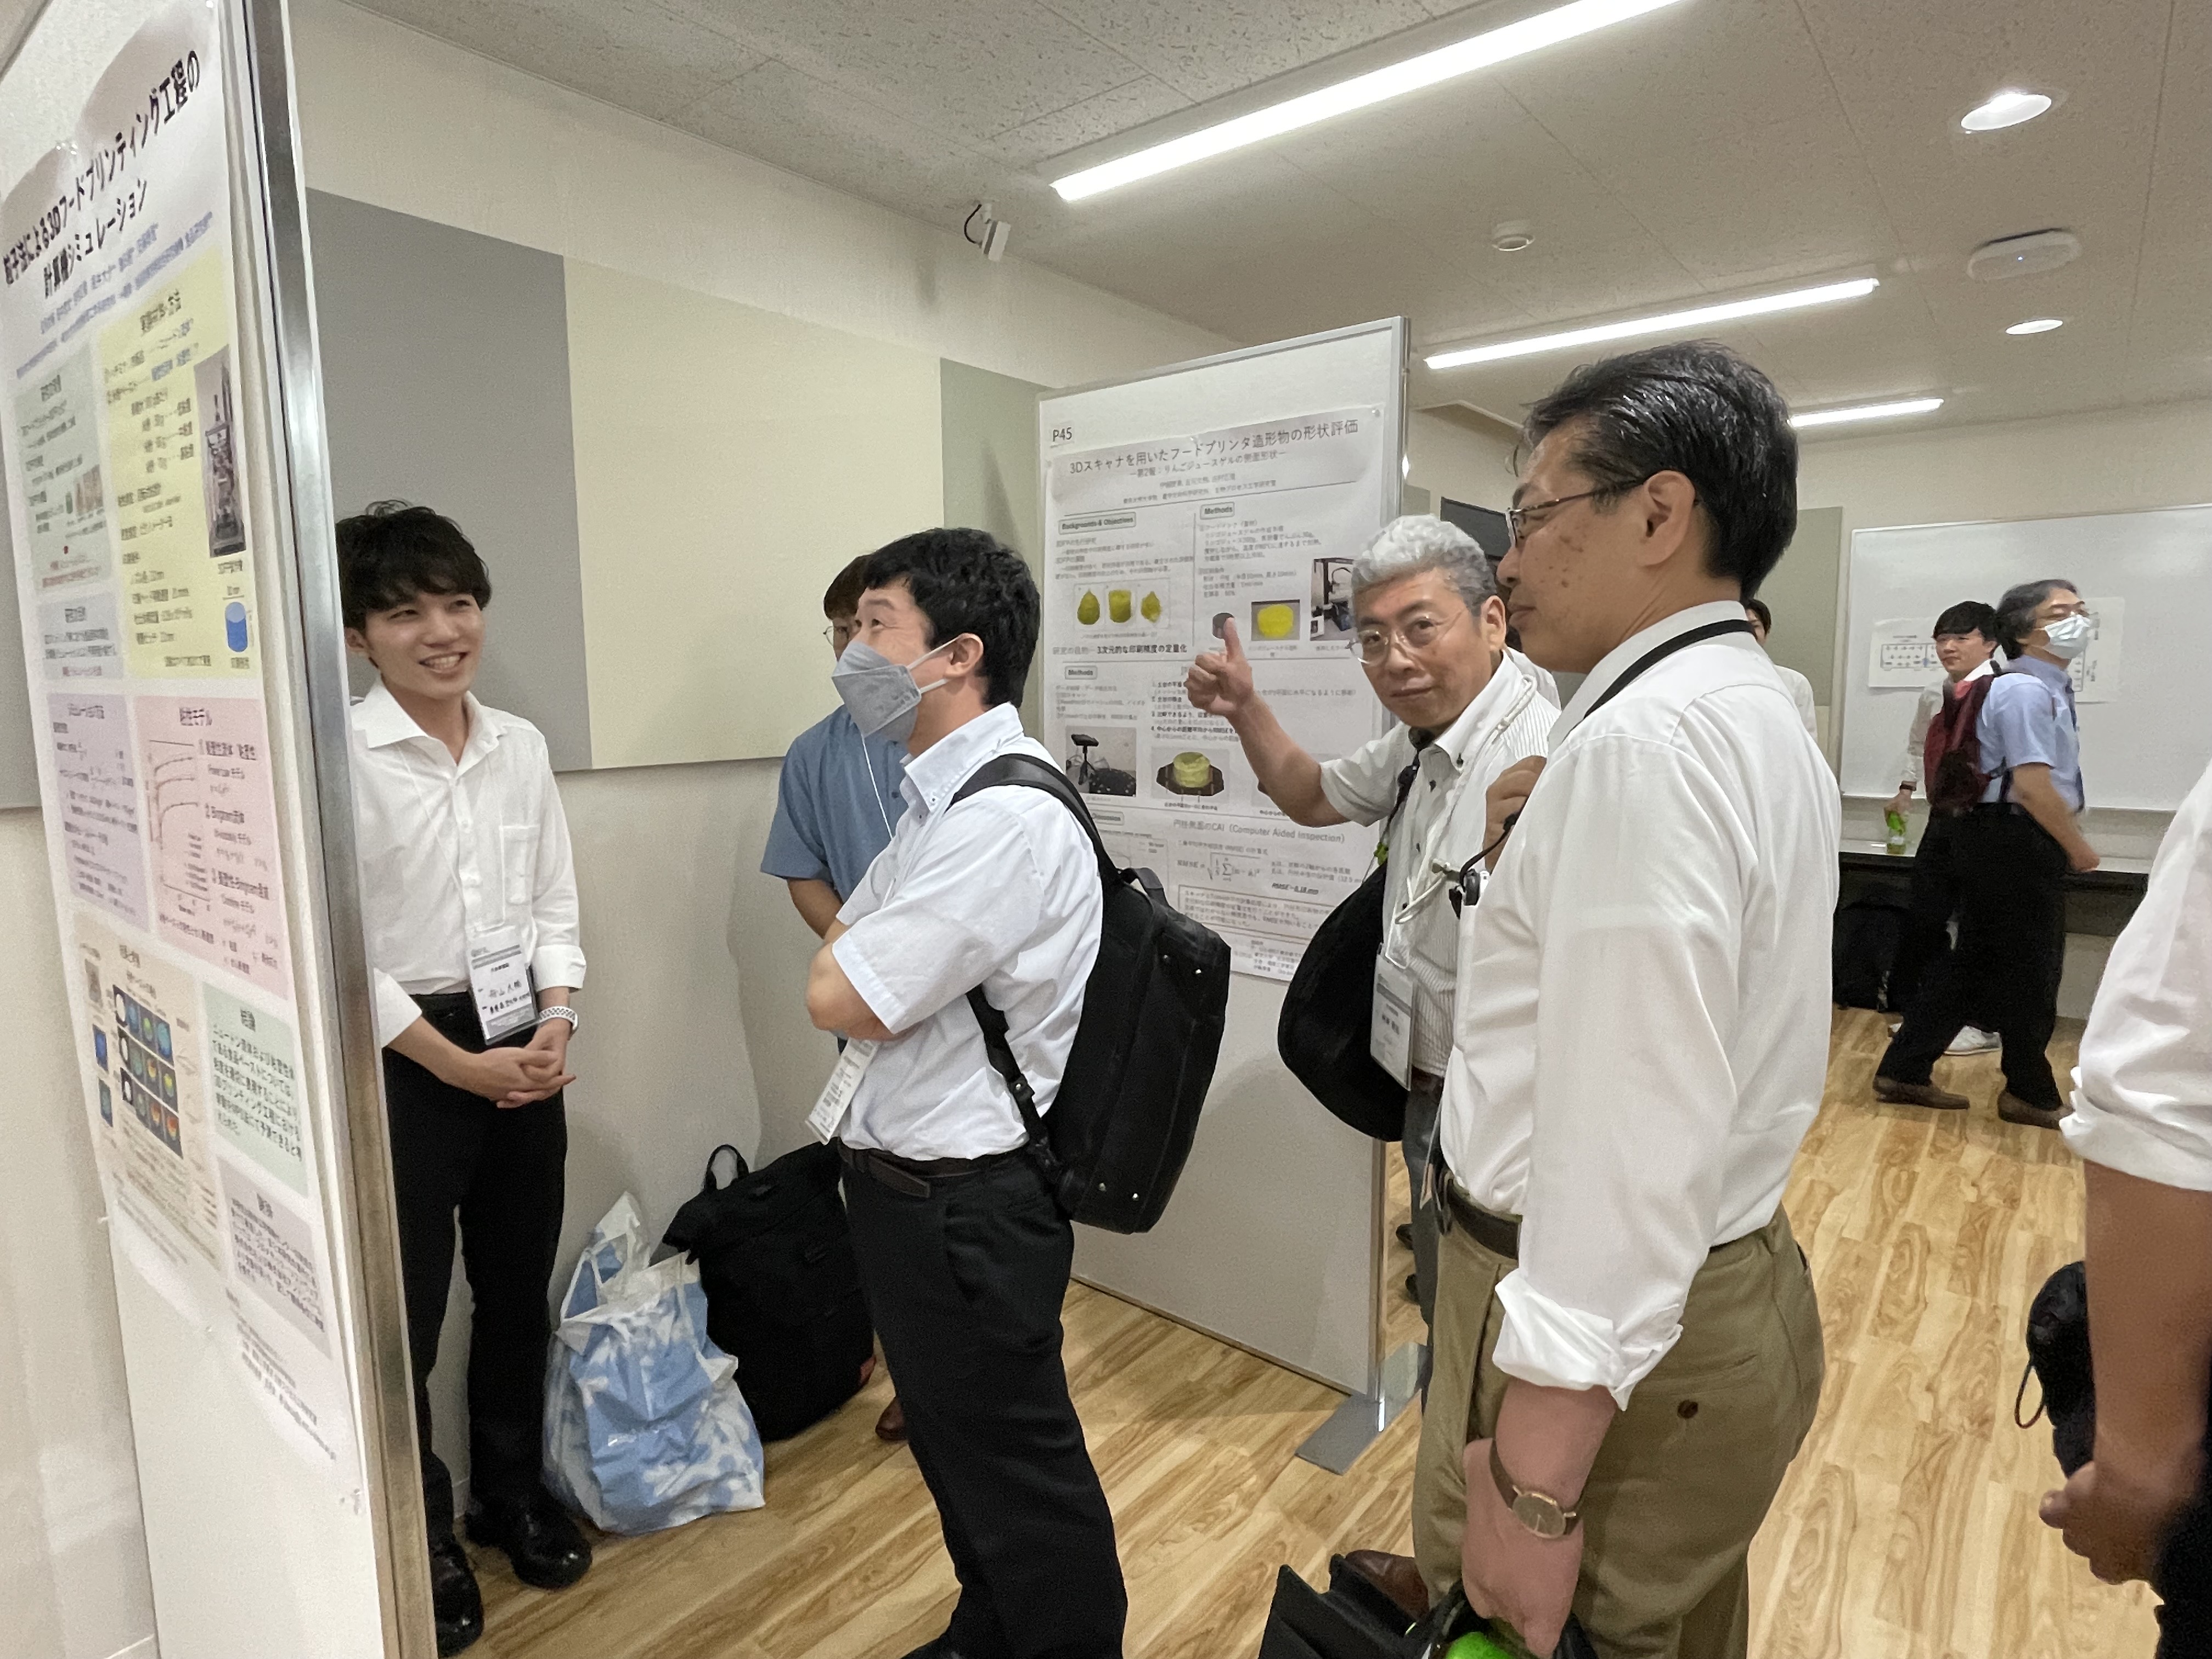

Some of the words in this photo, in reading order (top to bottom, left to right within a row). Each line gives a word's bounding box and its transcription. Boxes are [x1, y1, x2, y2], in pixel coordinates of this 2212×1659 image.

[1052, 427, 1073, 442] P45
[1070, 419, 1358, 474] 3Dスキャナを用いたフードプリンタ造形物の形状評価
